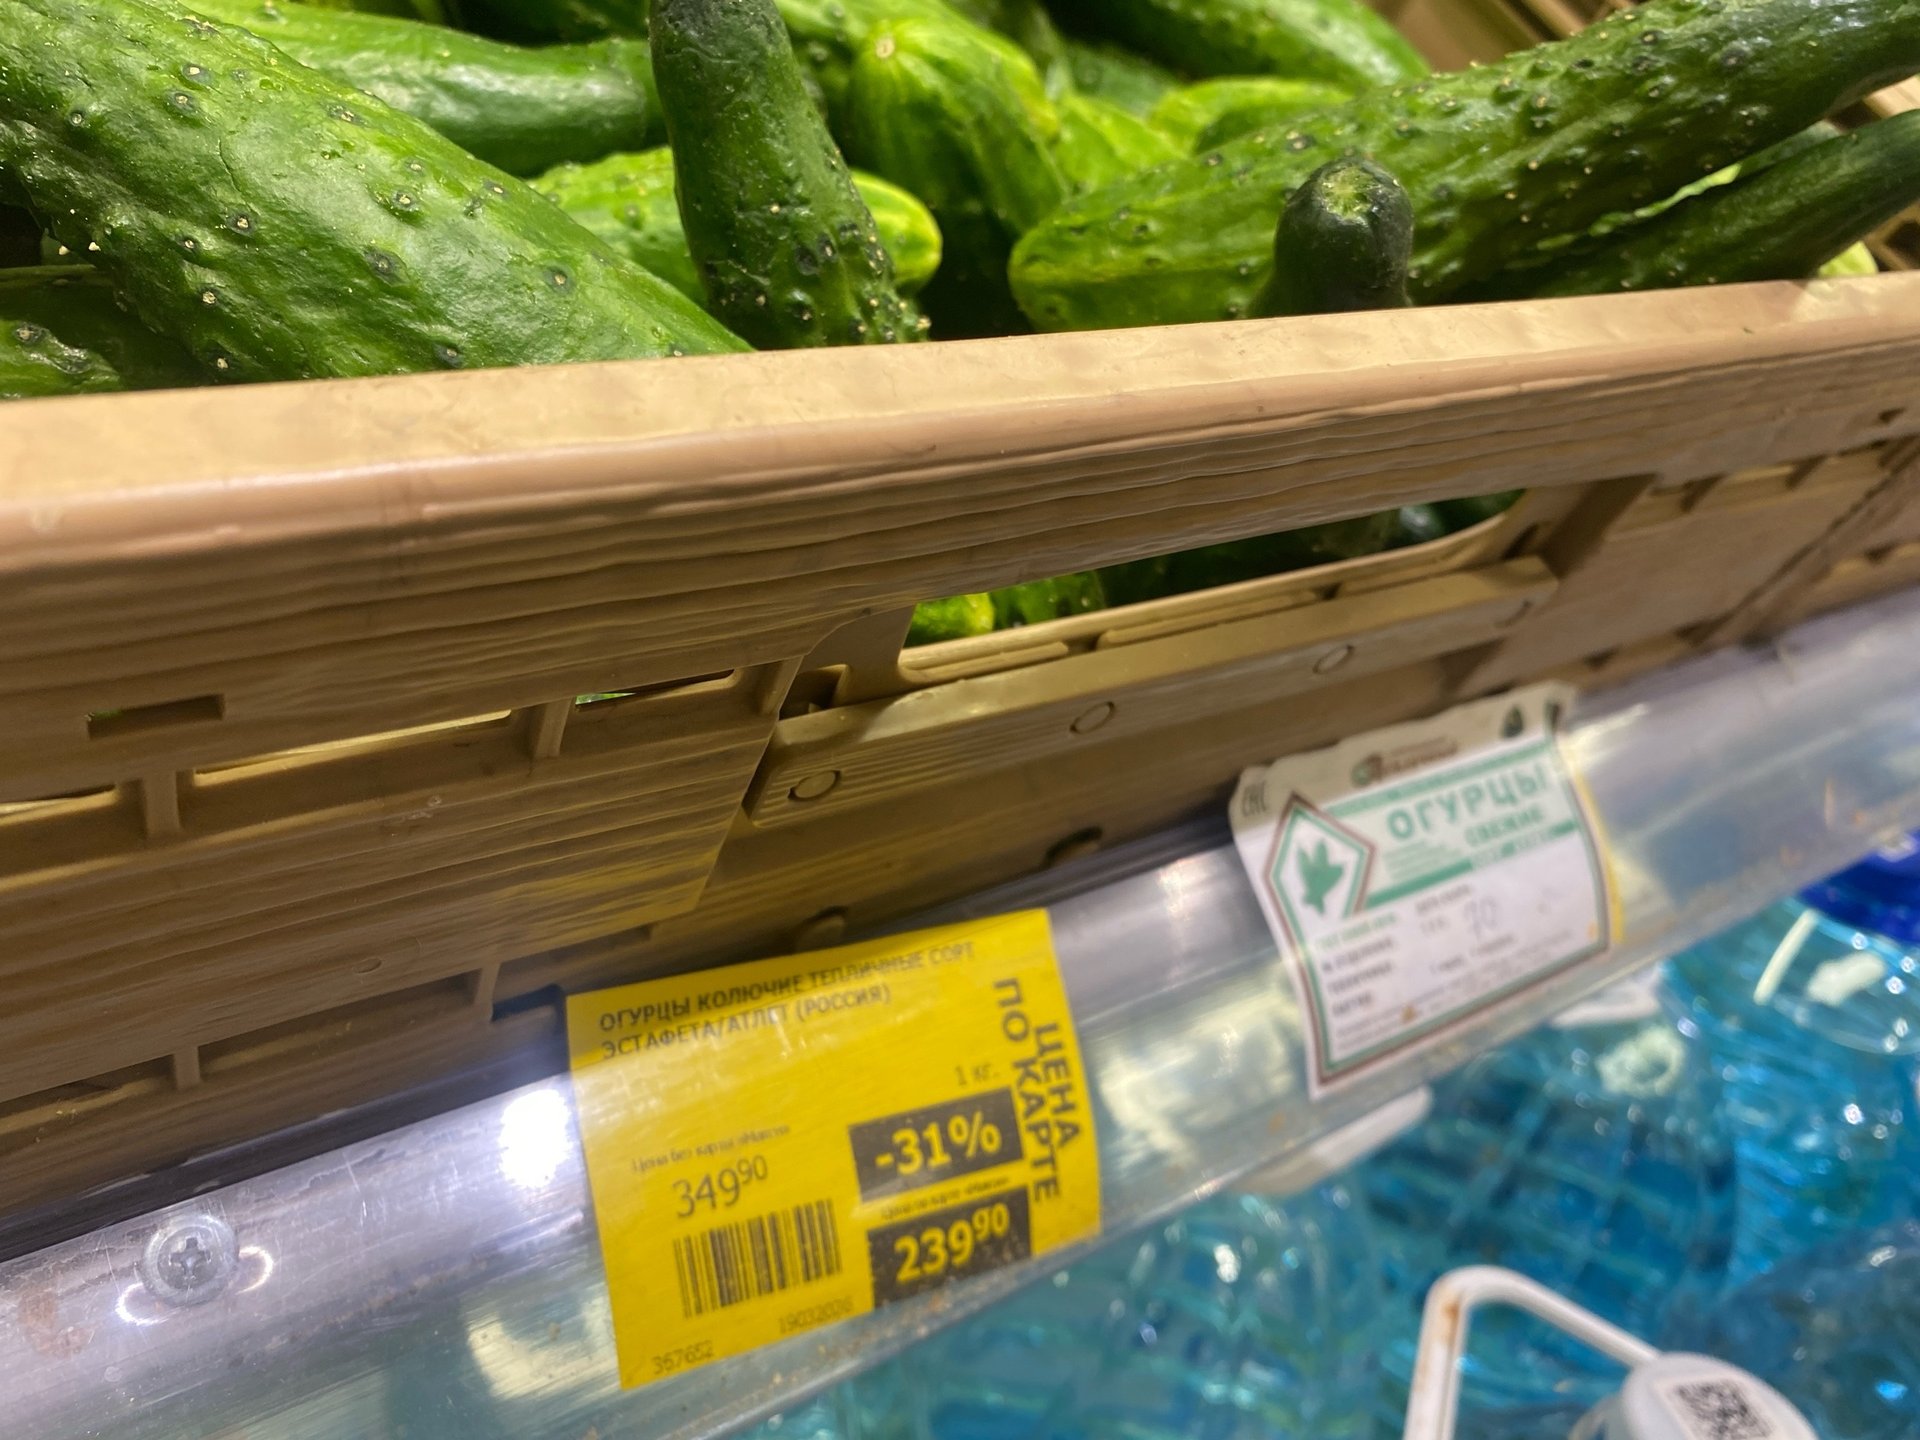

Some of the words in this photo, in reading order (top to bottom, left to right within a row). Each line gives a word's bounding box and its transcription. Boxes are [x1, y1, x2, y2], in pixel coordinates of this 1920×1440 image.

[1386, 763, 1547, 840] ОГУРЦЫ
[600, 996, 691, 1032] ОГУРЦЫ
[697, 973, 805, 1012] КОЛЮЧИЕ
[811, 951, 924, 988] ТЕПЛИЧНЫЕ
[928, 941, 974, 964] СОРТ
[601, 1004, 787, 1060] ЭСТАФЕТА/АТЛЕТ
[796, 982, 891, 1022] (РОССИЯ)
[955, 1065, 967, 1086] 1
[994, 977, 1030, 1043] ПО
[1013, 1056, 1061, 1201] КАРТЕ
[1035, 1023, 1081, 1148] ЦЕНА
[875, 1110, 1002, 1175] -31%
